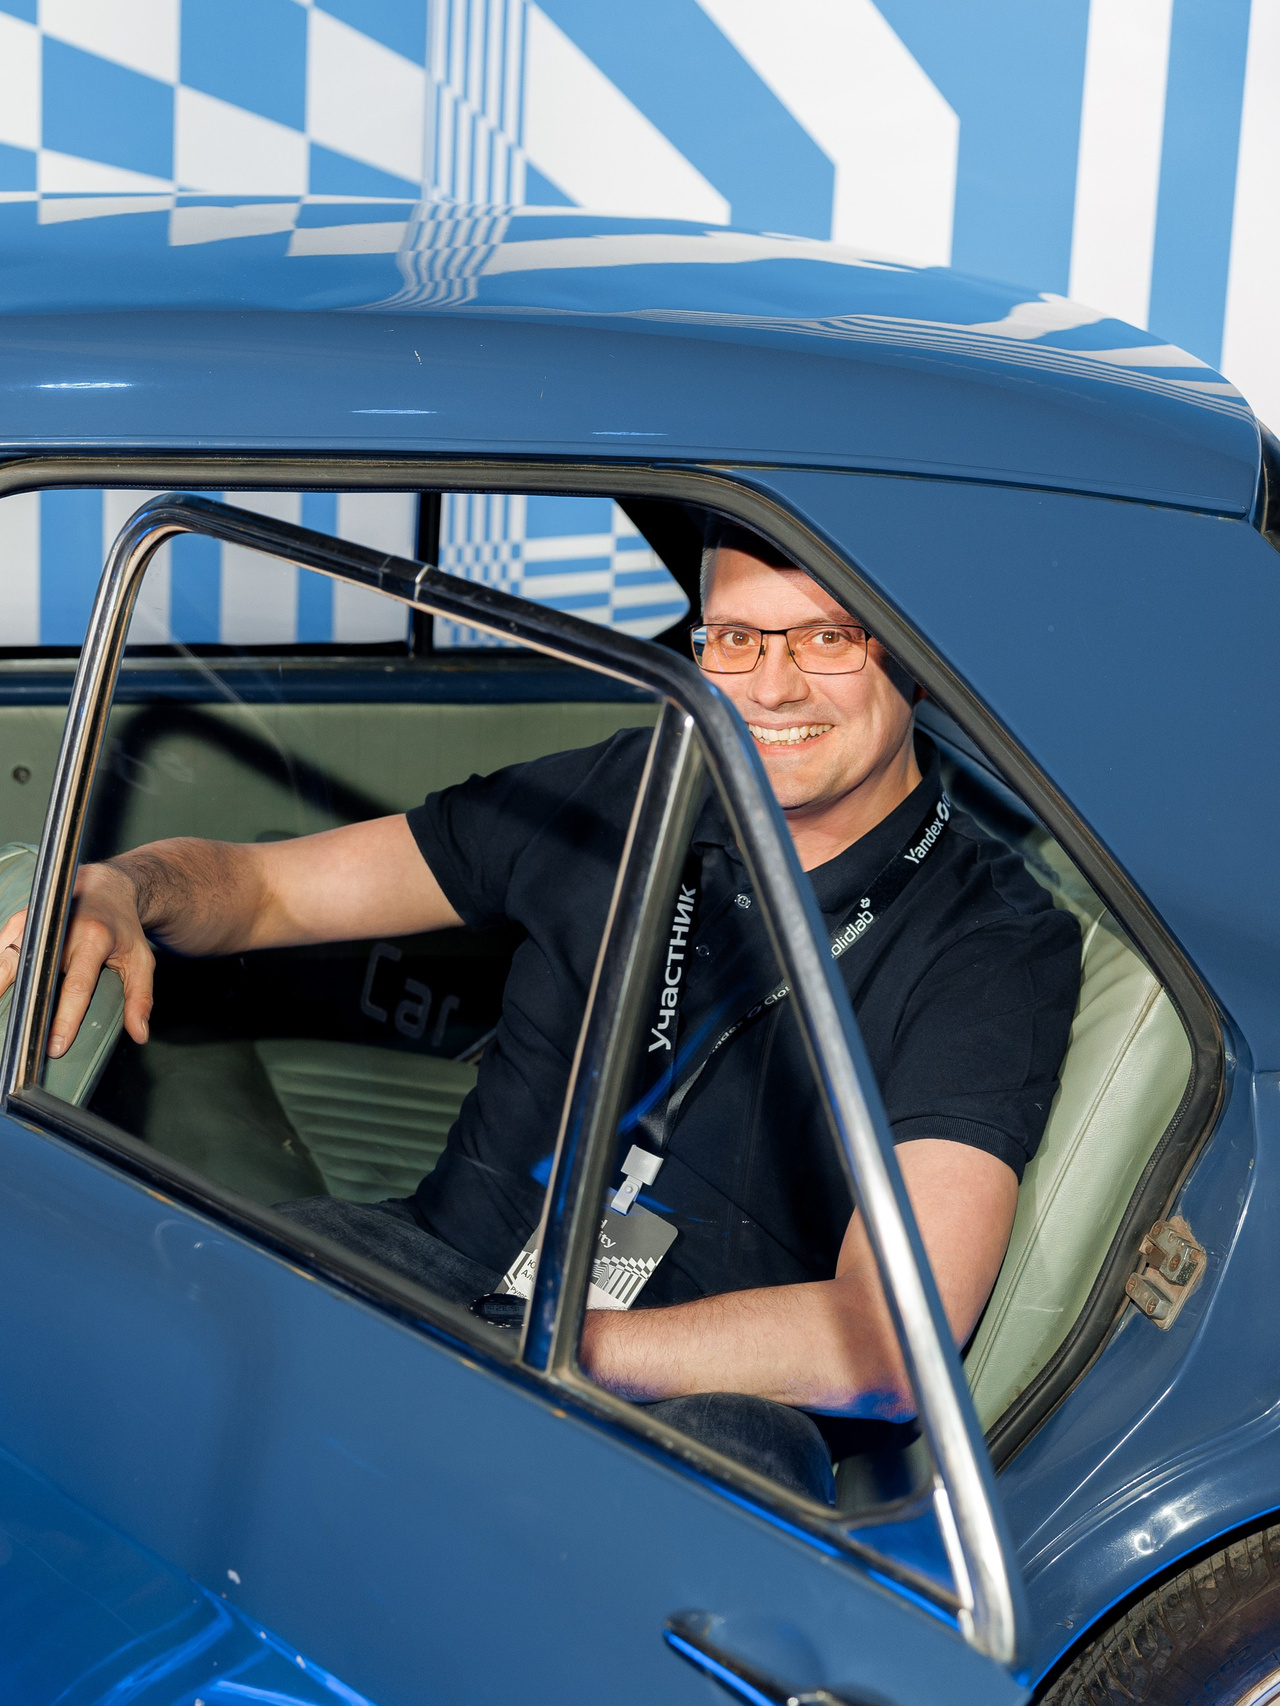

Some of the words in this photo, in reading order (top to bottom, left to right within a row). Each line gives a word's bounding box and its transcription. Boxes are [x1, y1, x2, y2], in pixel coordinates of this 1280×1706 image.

[903, 818, 944, 864] Yandex
[361, 942, 460, 1047] Car
[648, 884, 696, 1052] Участник
[764, 985, 790, 1005] Clo
